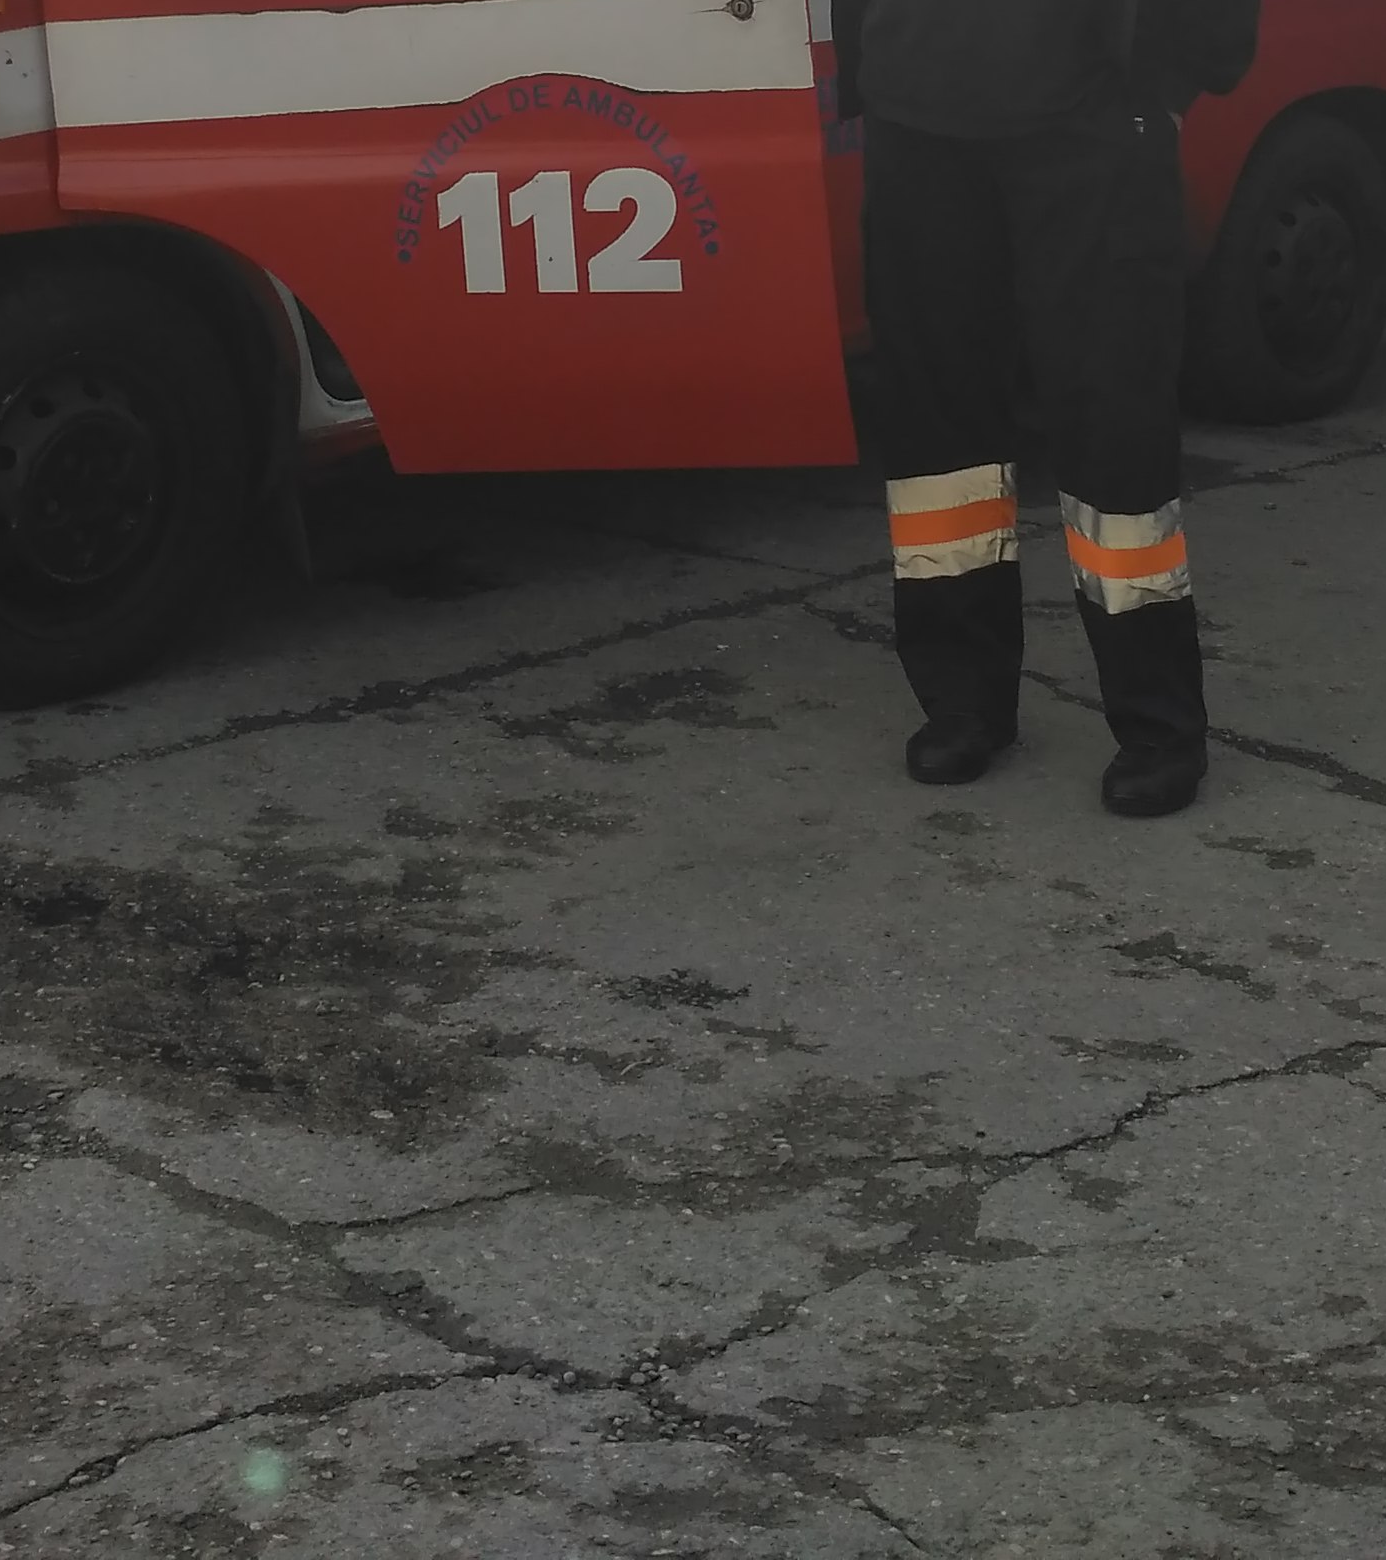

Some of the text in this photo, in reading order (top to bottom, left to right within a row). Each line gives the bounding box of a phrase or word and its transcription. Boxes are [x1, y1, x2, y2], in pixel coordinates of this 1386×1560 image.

[397, 82, 720, 248] SERVICIUL DE AMBULANTA
[437, 167, 683, 294] 112
